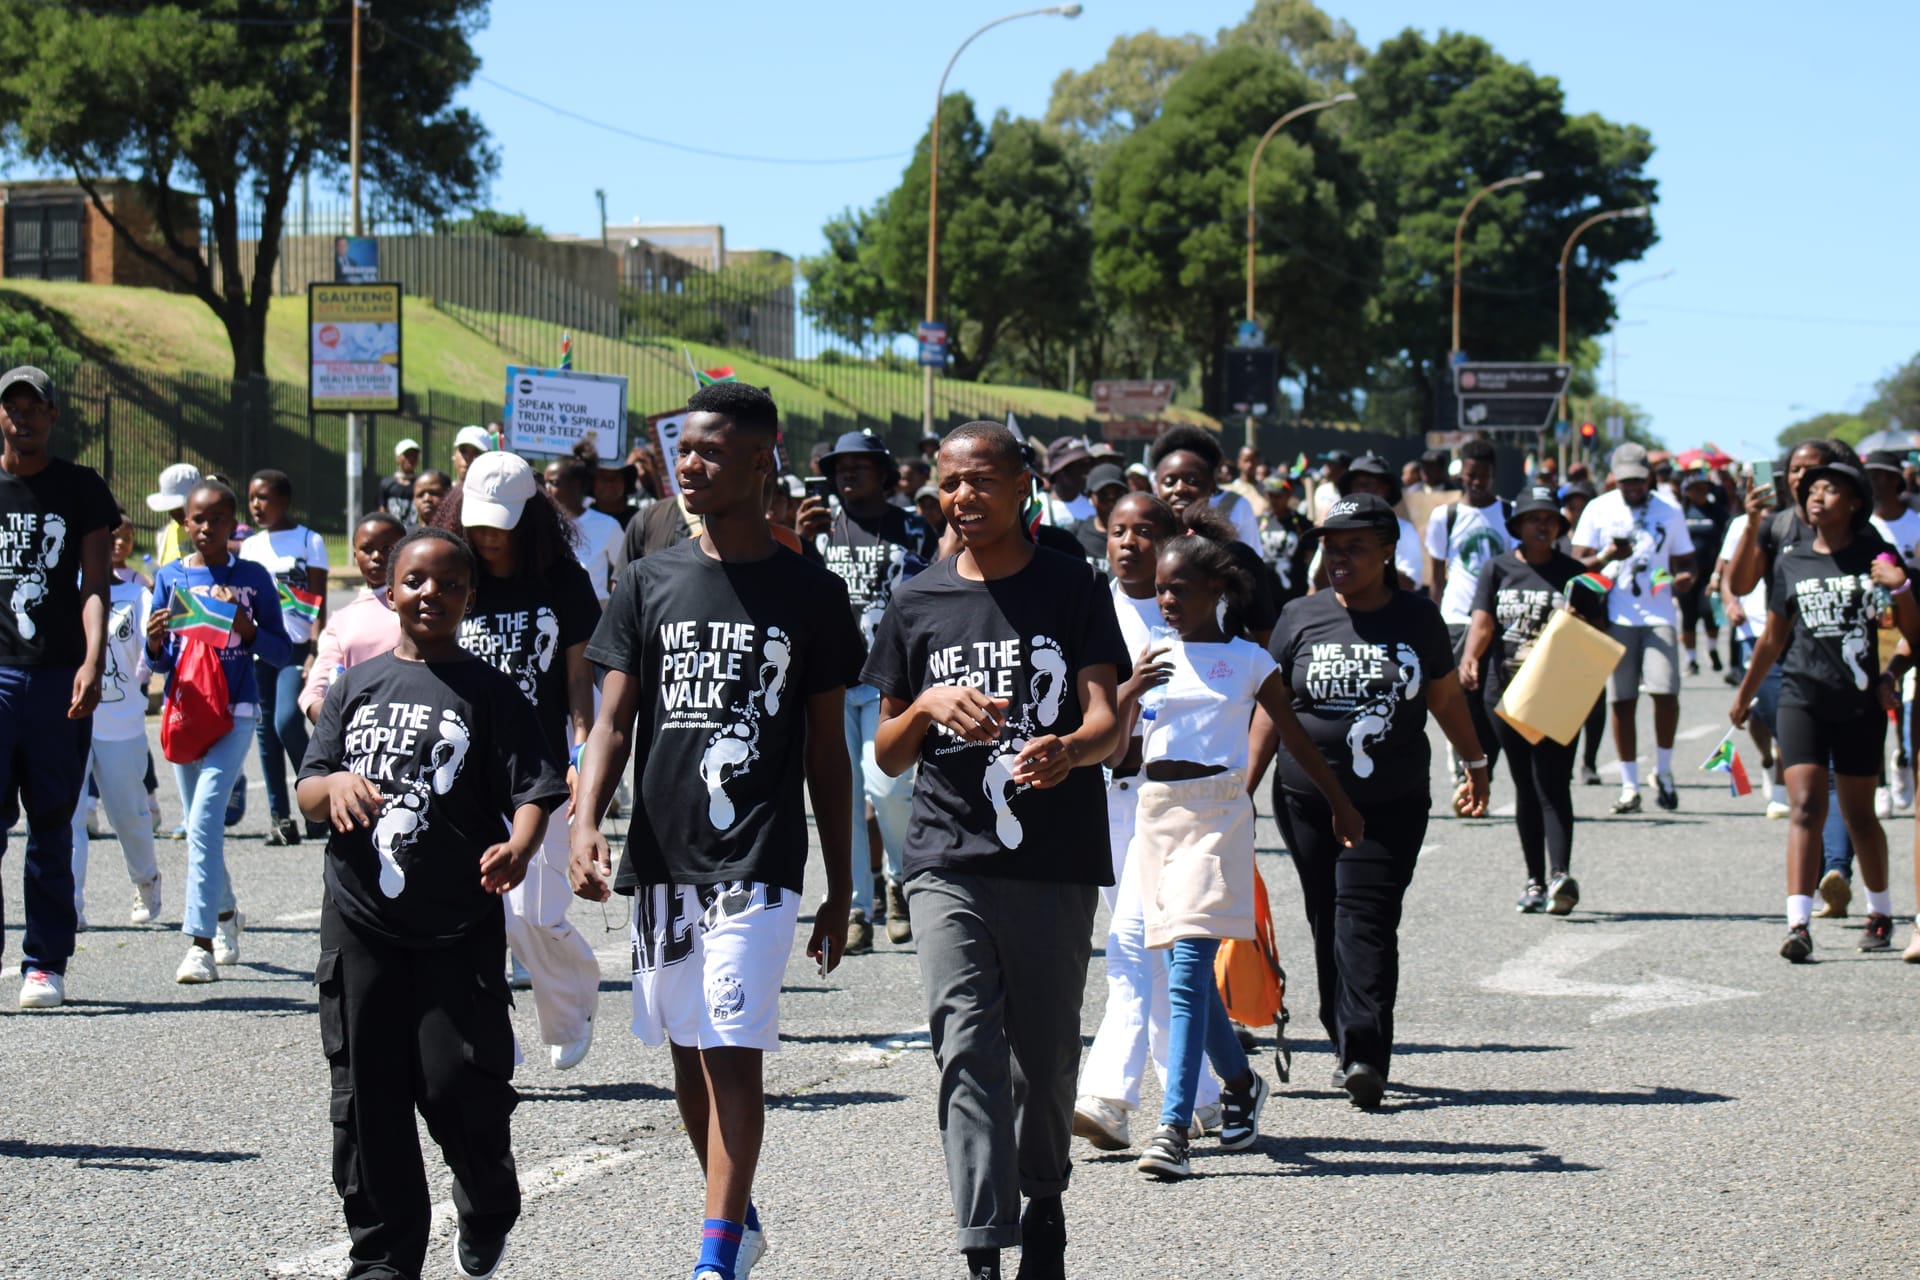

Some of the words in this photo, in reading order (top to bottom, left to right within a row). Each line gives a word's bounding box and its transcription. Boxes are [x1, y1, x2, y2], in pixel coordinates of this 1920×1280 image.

[318, 291, 393, 303] GAUTENG
[345, 304, 393, 313] COLLEGE
[319, 375, 353, 384] HEALTH
[355, 375, 393, 384] STUDIES
[518, 399, 554, 411] SPEAK
[558, 402, 587, 414] YOUR
[518, 410, 556, 425] TRUTH,
[571, 416, 615, 430] SPREAD
[517, 423, 546, 434] YOUR
[549, 426, 584, 438] STEEZ
[6, 513, 37, 531] THE
[0, 550, 23, 567] LK
[856, 545, 884, 562] THE
[826, 562, 878, 578] PEOPLE
[848, 578, 870, 594] ALK
[1825, 575, 1856, 591] THE
[1522, 590, 1549, 606] THE
[1798, 590, 1852, 612] PEOPLE
[1496, 603, 1541, 621] PEOPLE
[1802, 608, 1845, 628] WALK
[461, 616, 490, 637] WE,
[495, 611, 529, 633] THE
[459, 632, 522, 656] PEOPLE
[660, 621, 700, 651] WE,
[708, 621, 755, 653] THE
[929, 645, 970, 679] WE,
[972, 638, 1021, 668] THE
[1312, 643, 1346, 661] WE,
[1350, 643, 1389, 661] THE
[661, 651, 742, 682] PEOPLE
[1306, 659, 1383, 680] PEOPLE
[661, 681, 724, 711] WALK
[1306, 679, 1370, 700] WALK
[388, 702, 432, 730] THE
[670, 711, 708, 720] Affirming
[345, 726, 417, 756] PEOPLE
[713, 1008, 729, 1020] BB
